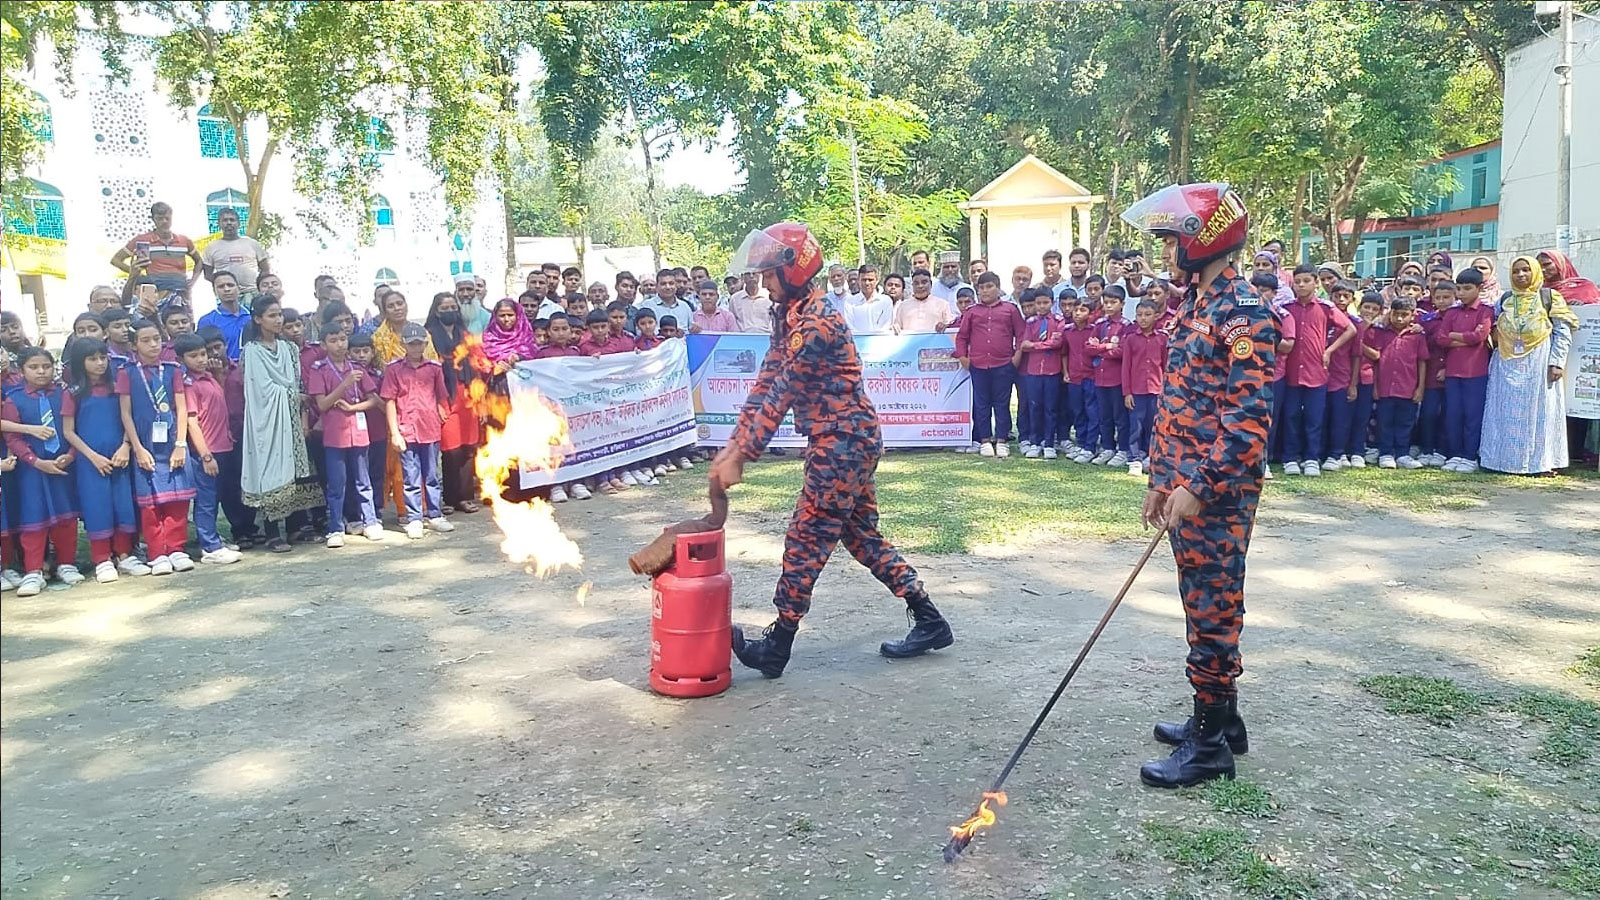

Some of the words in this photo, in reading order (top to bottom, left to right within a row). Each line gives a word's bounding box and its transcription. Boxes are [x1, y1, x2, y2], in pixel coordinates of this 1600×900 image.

[707, 376, 740, 395] আলোচনা
[867, 371, 892, 394] করণীয়
[894, 372, 920, 394] বিষয়ক
[922, 377, 942, 396] মহড়া
[921, 427, 964, 437] actionaid
